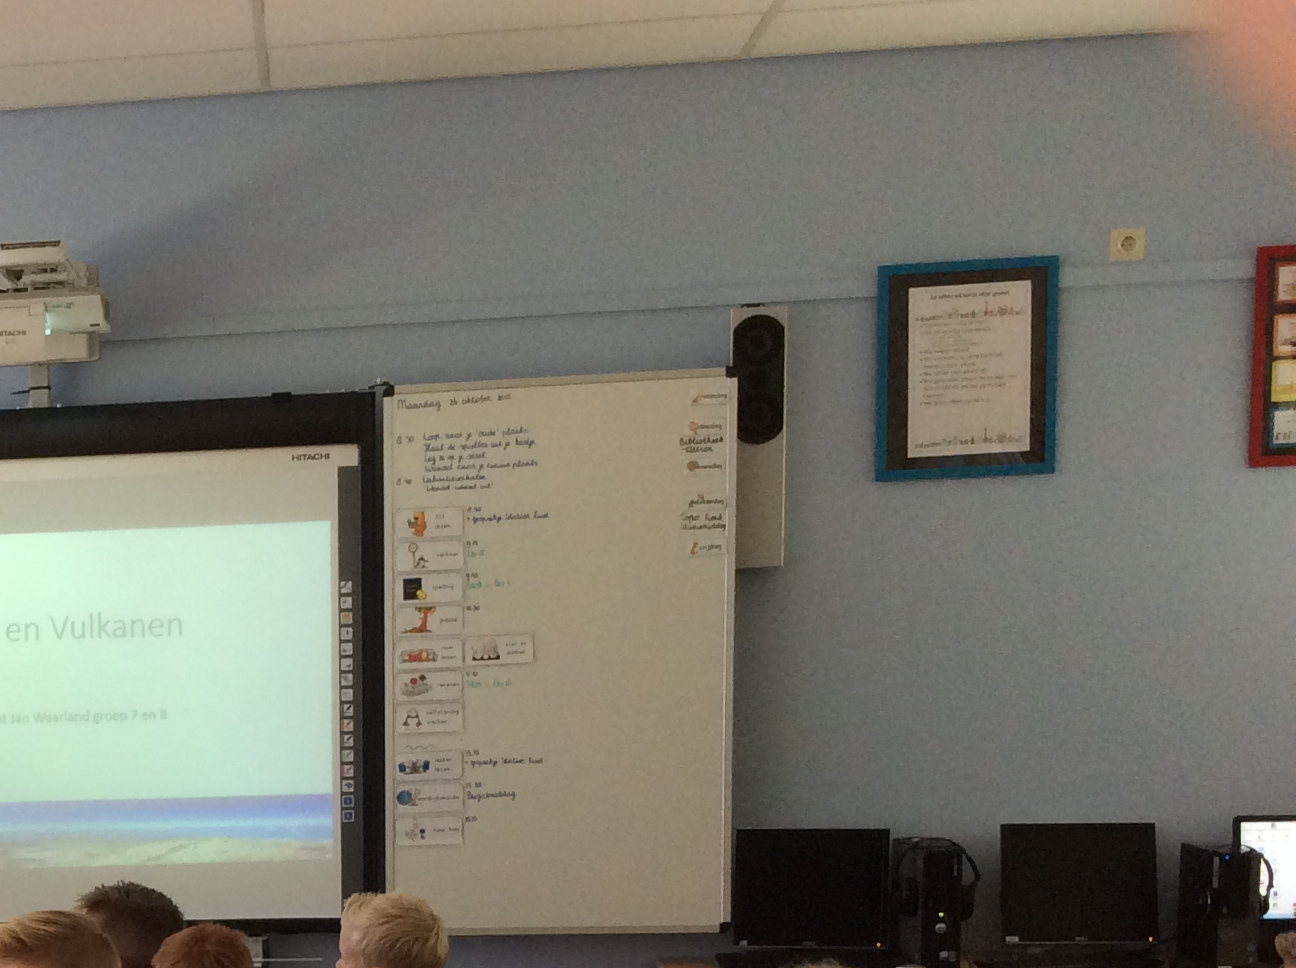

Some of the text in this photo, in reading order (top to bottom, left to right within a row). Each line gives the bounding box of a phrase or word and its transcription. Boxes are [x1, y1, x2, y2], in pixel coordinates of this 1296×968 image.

[398, 399, 440, 413] Maandag
[292, 453, 330, 461] HITACHI
[5, 619, 40, 642] en
[49, 611, 183, 641] Vulkanen
[10, 713, 30, 724] Jan
[33, 711, 90, 724] Waarland
[92, 710, 127, 726] groep
[131, 710, 137, 720] 7
[142, 711, 156, 721] en
